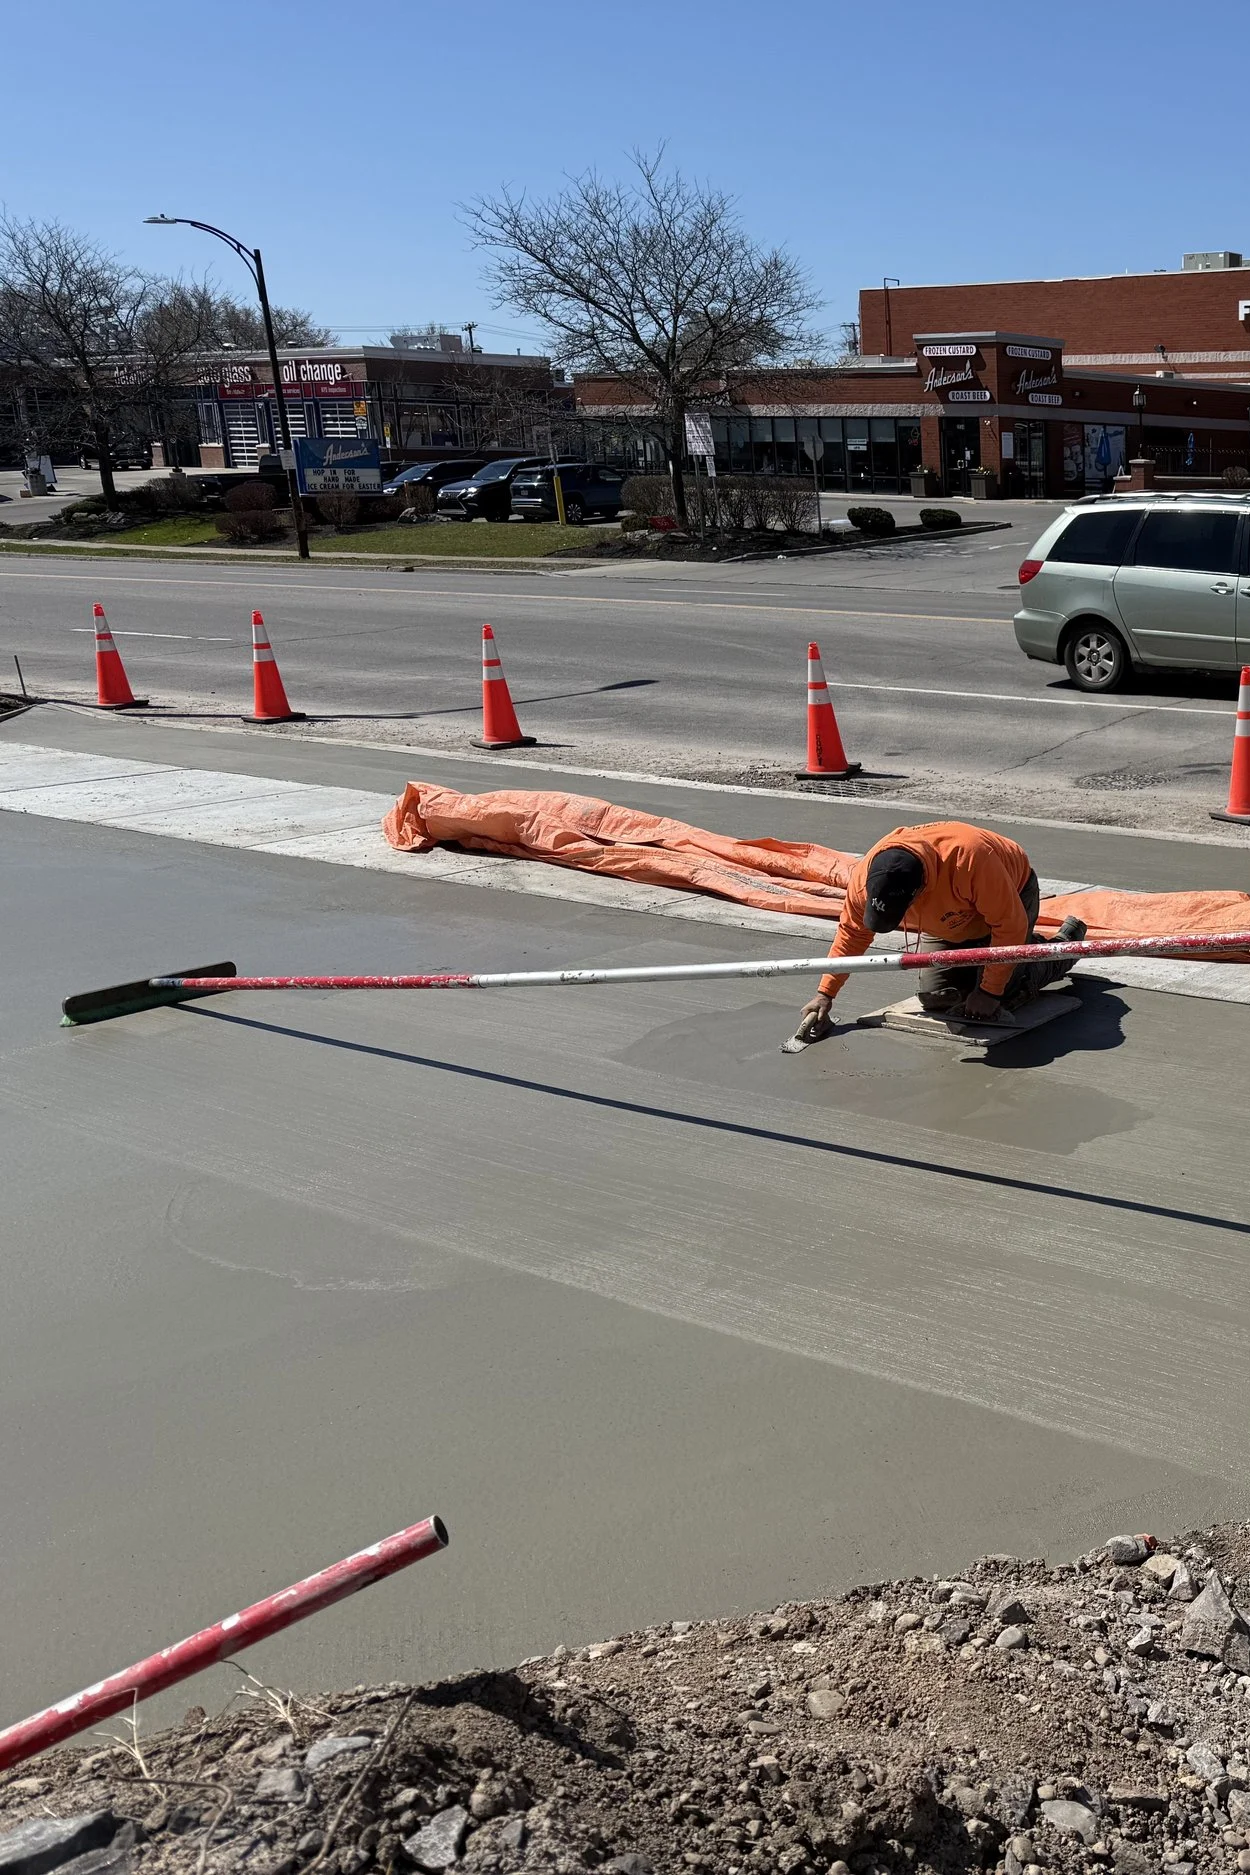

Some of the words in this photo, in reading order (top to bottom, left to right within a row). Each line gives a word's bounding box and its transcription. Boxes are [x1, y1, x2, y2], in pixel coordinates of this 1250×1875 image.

[925, 346, 947, 355] FROZEN
[948, 345, 974, 355] CUSTARD
[1008, 347, 1028, 356] FROZEN
[1028, 348, 1050, 359] CUSTARD
[222, 363, 252, 388] glass
[283, 360, 297, 382] oil
[300, 360, 342, 385] change
[923, 360, 973, 393] Anderson's
[1016, 365, 1057, 395] Anderson's
[951, 391, 971, 400] ROAST
[972, 391, 987, 400] BEEF
[1031, 394, 1046, 403] ROAST
[1047, 395, 1061, 404] BEEF
[323, 442, 371, 467] Anderson's
